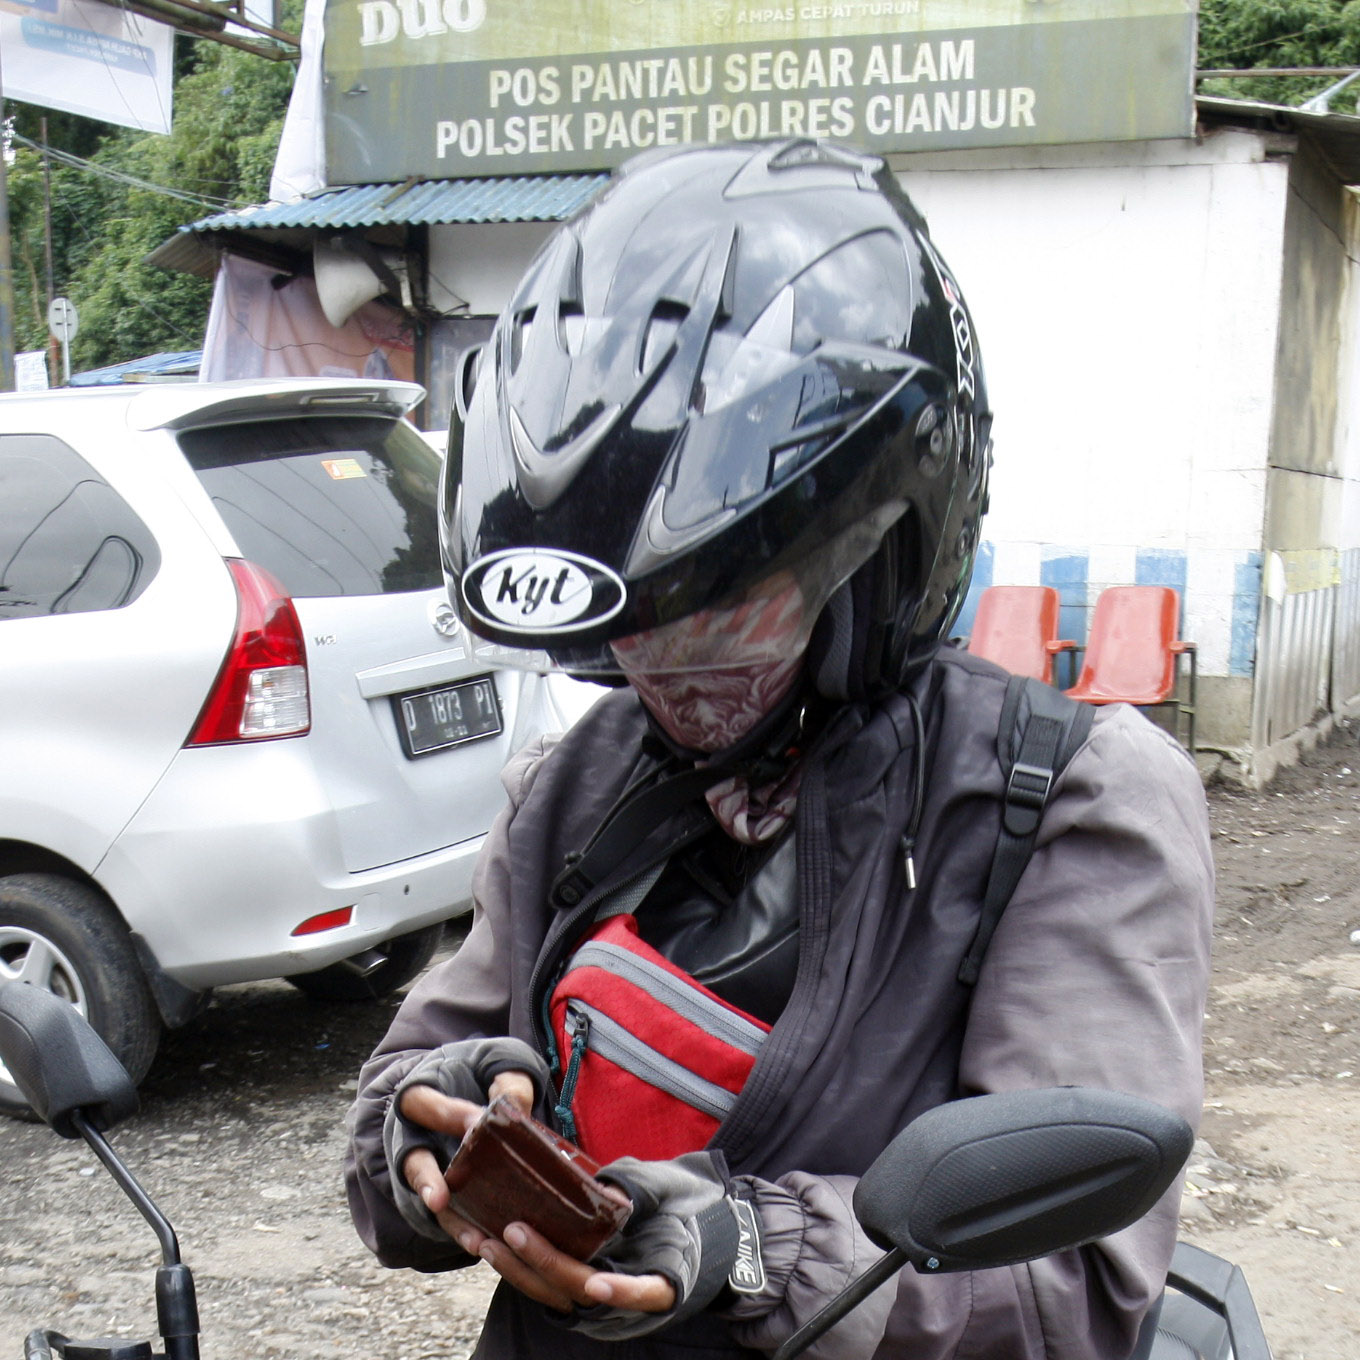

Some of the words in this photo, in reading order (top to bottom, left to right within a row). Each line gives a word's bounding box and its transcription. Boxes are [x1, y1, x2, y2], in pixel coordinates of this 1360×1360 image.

[737, 8, 795, 25] AMPAS
[800, 4, 854, 21] CEPAT
[861, 1, 921, 17] TURUN
[490, 66, 561, 108] POS
[571, 55, 713, 104] PANTAU
[724, 47, 854, 93] SEGAR
[862, 39, 976, 86] ALAM
[436, 113, 575, 159] POLSEK
[584, 105, 699, 151] PACET
[707, 97, 855, 143] POLRES
[865, 87, 1037, 136] CIANJUR
[429, 691, 463, 726] 1873
[474, 684, 494, 716] PI
[735, 1230, 757, 1284] NIKE
